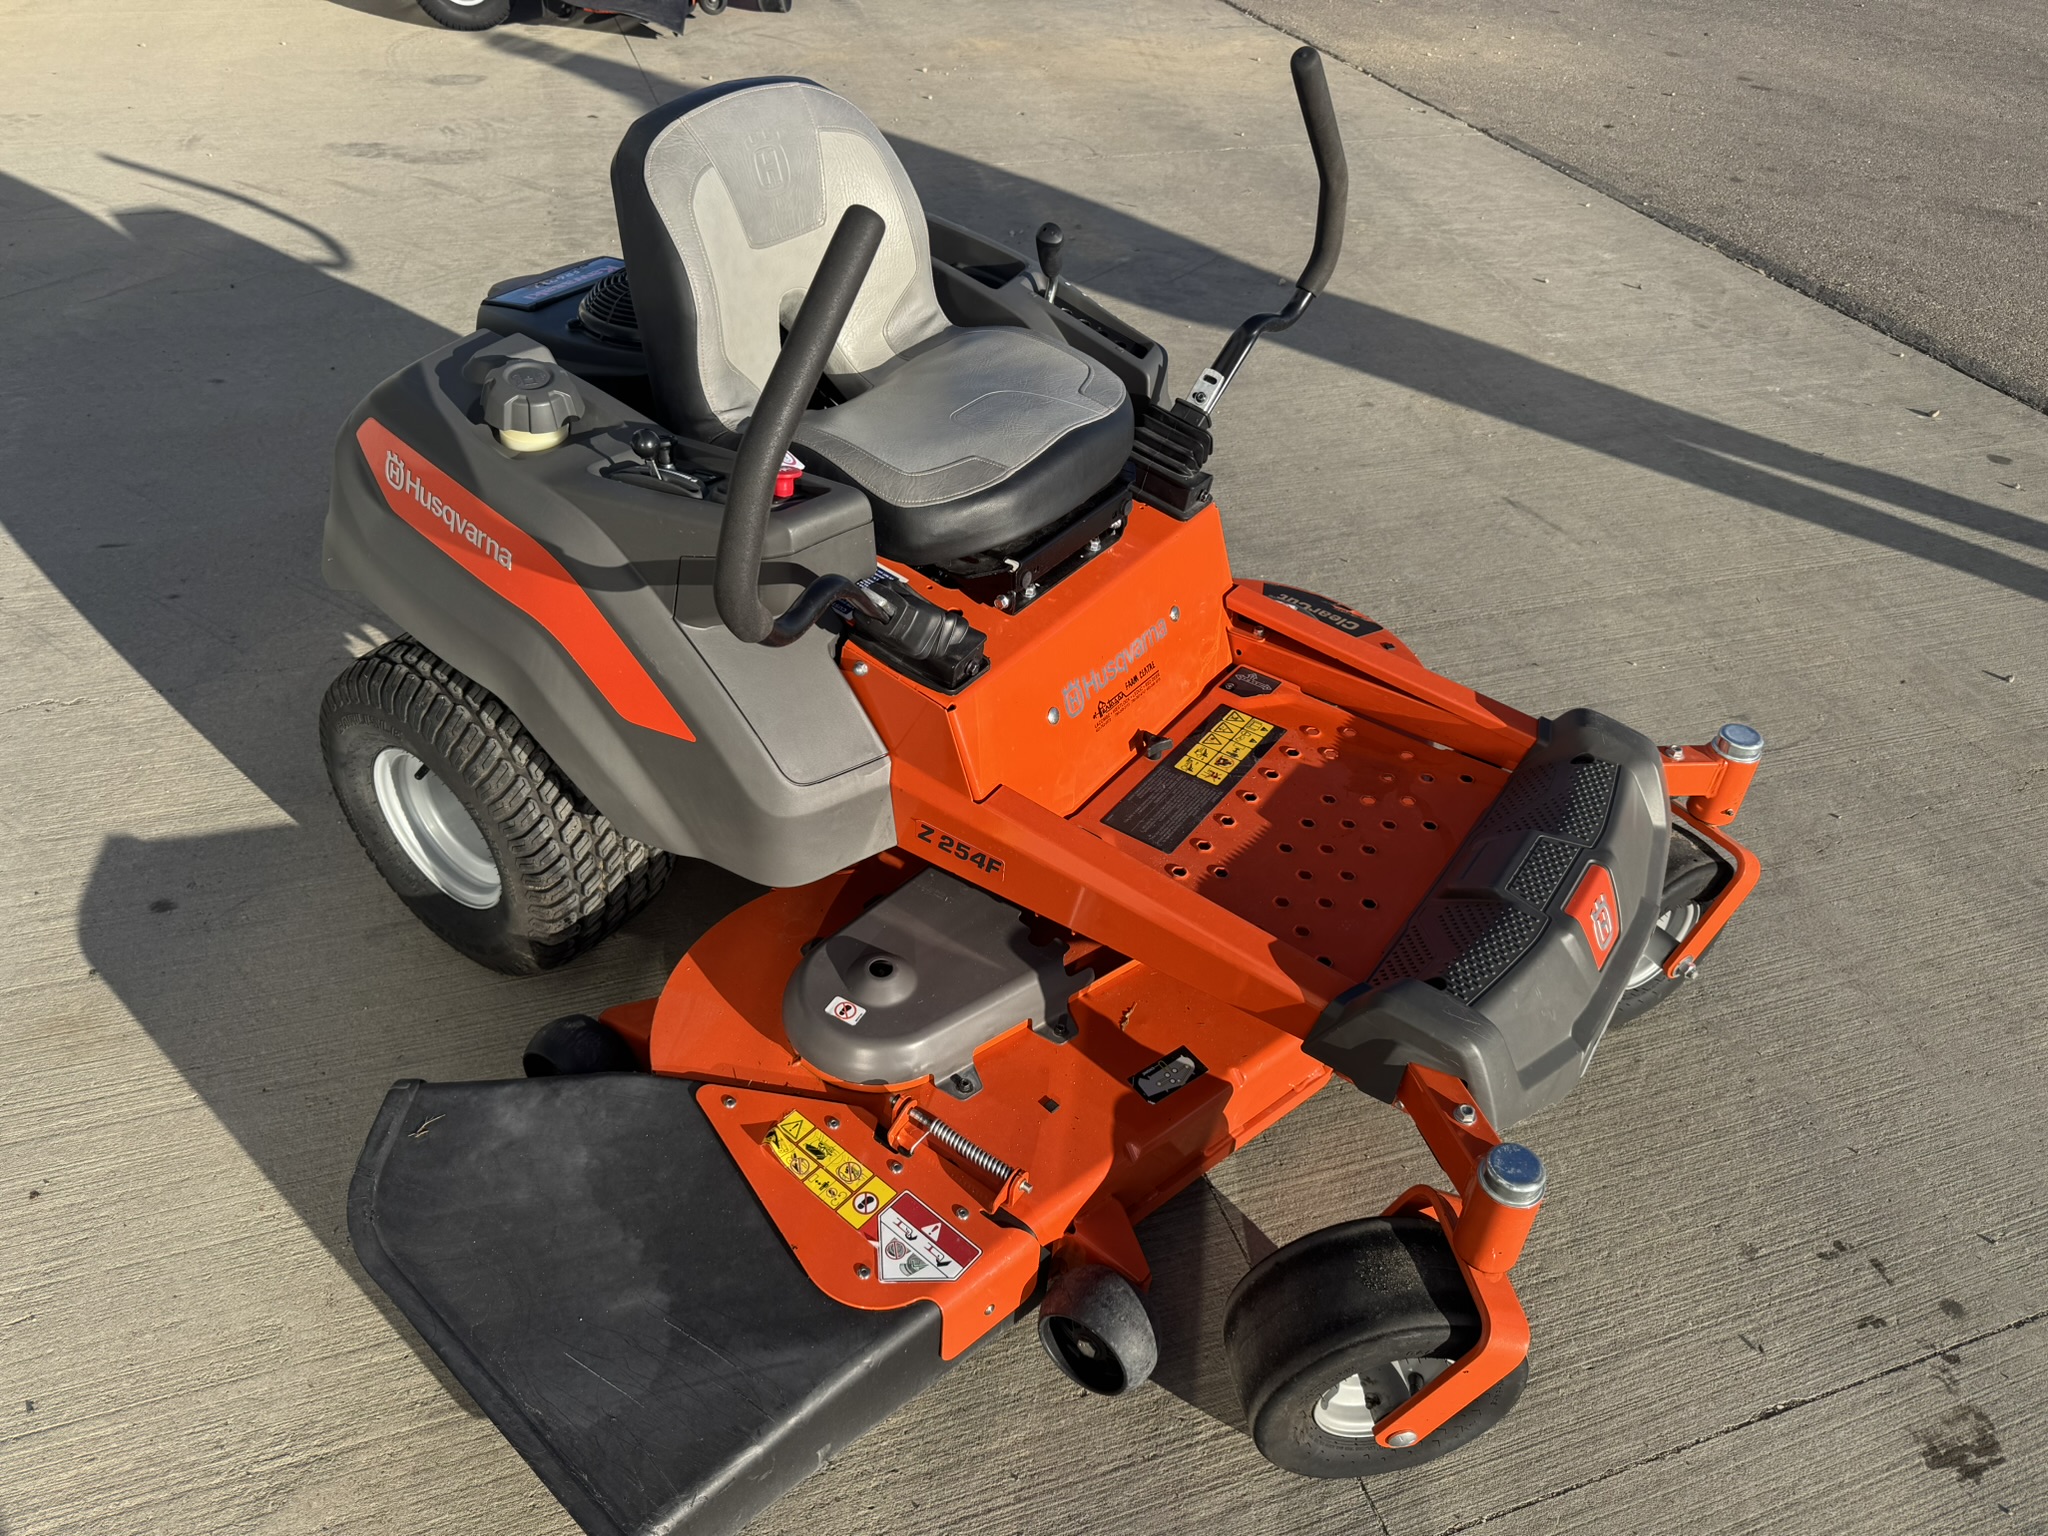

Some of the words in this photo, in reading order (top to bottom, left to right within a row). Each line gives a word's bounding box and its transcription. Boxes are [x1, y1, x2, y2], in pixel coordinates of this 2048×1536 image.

[406, 469, 512, 571] Husqvarna
[1276, 593, 1361, 630] ClearCut
[1082, 618, 1168, 700] Husqvarna
[1125, 674, 1139, 690] FARM
[1139, 660, 1156, 679] CENTRE
[917, 823, 935, 844] Z
[938, 834, 1002, 873] 254F
